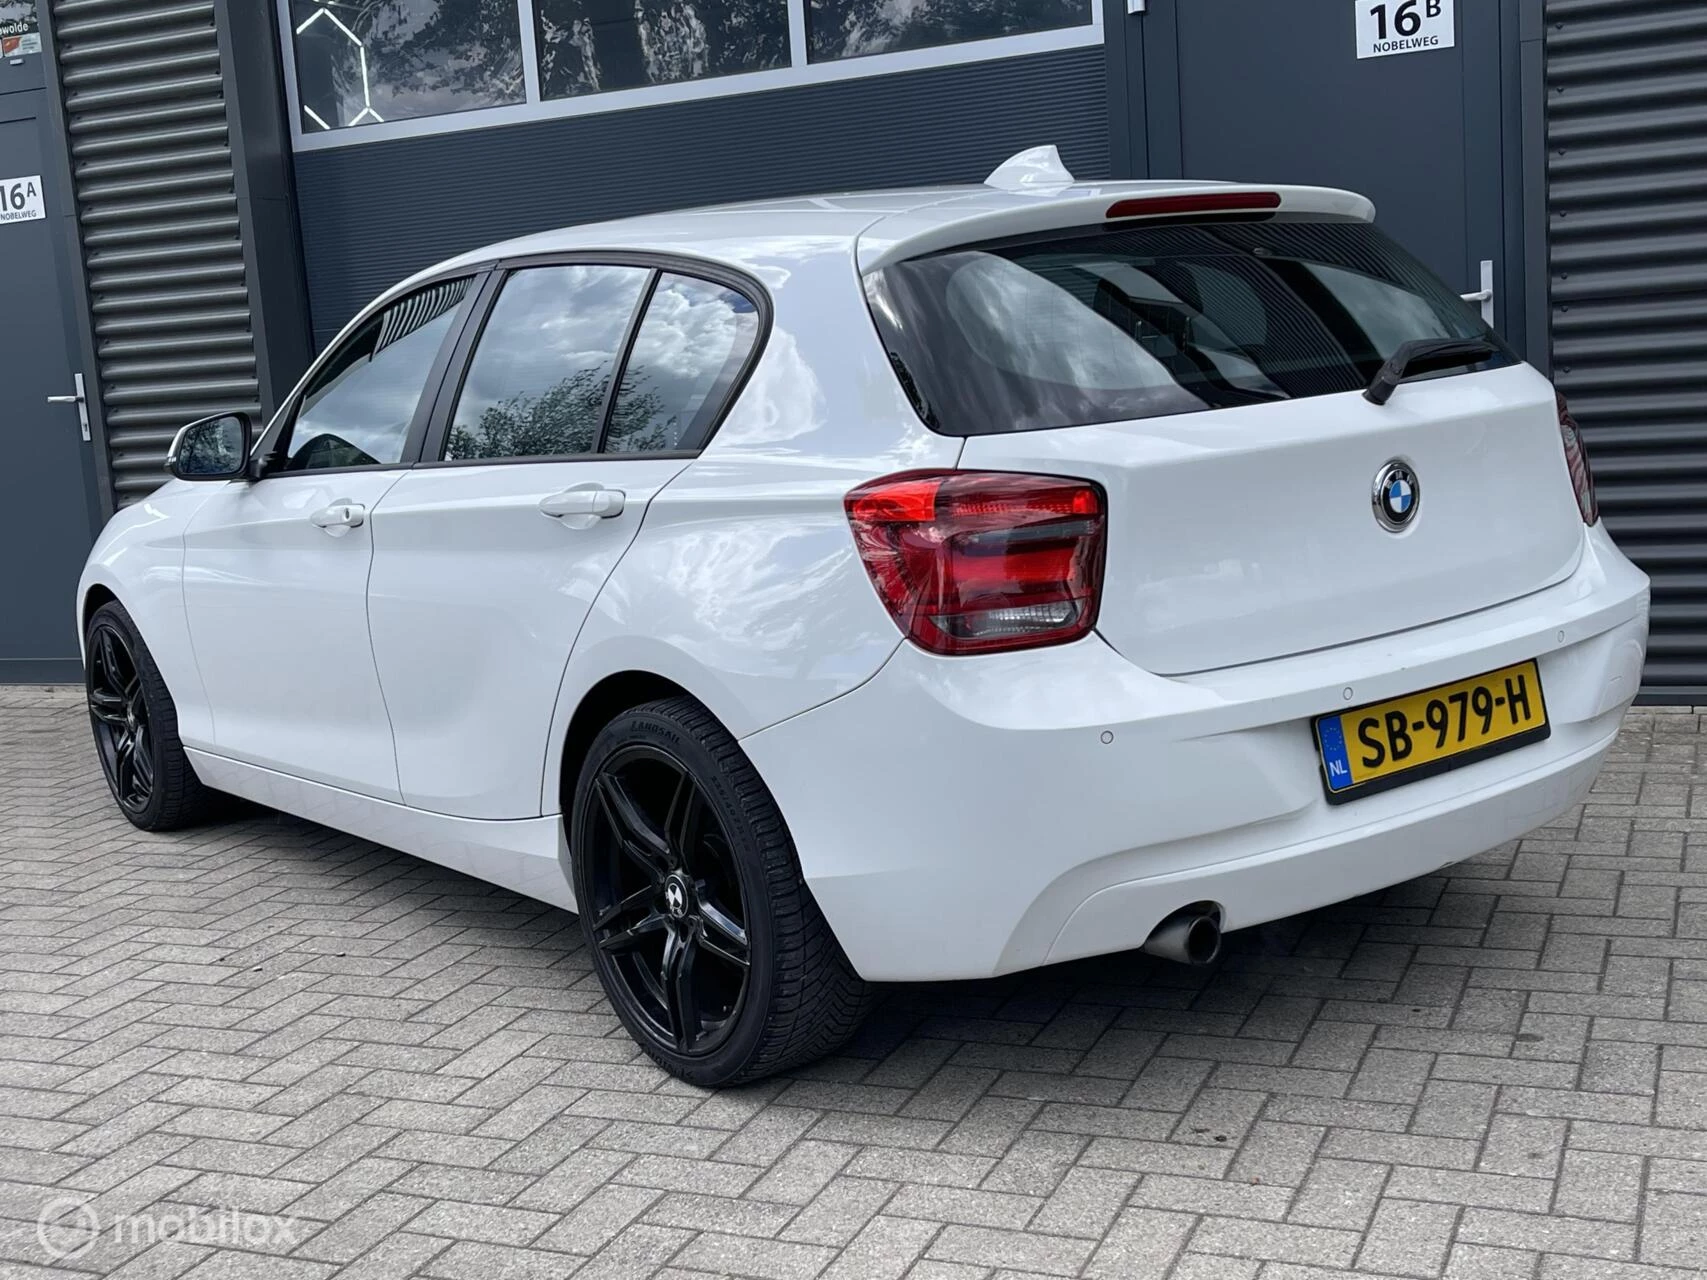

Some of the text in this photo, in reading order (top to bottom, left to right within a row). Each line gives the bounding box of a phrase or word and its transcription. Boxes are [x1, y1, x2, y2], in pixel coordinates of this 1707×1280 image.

[1373, 35, 1439, 53] NOBELWEG
[0, 209, 37, 221] NOBELWEG
[1358, 674, 1531, 768] SB-979-H
[1329, 760, 1348, 777] NL
